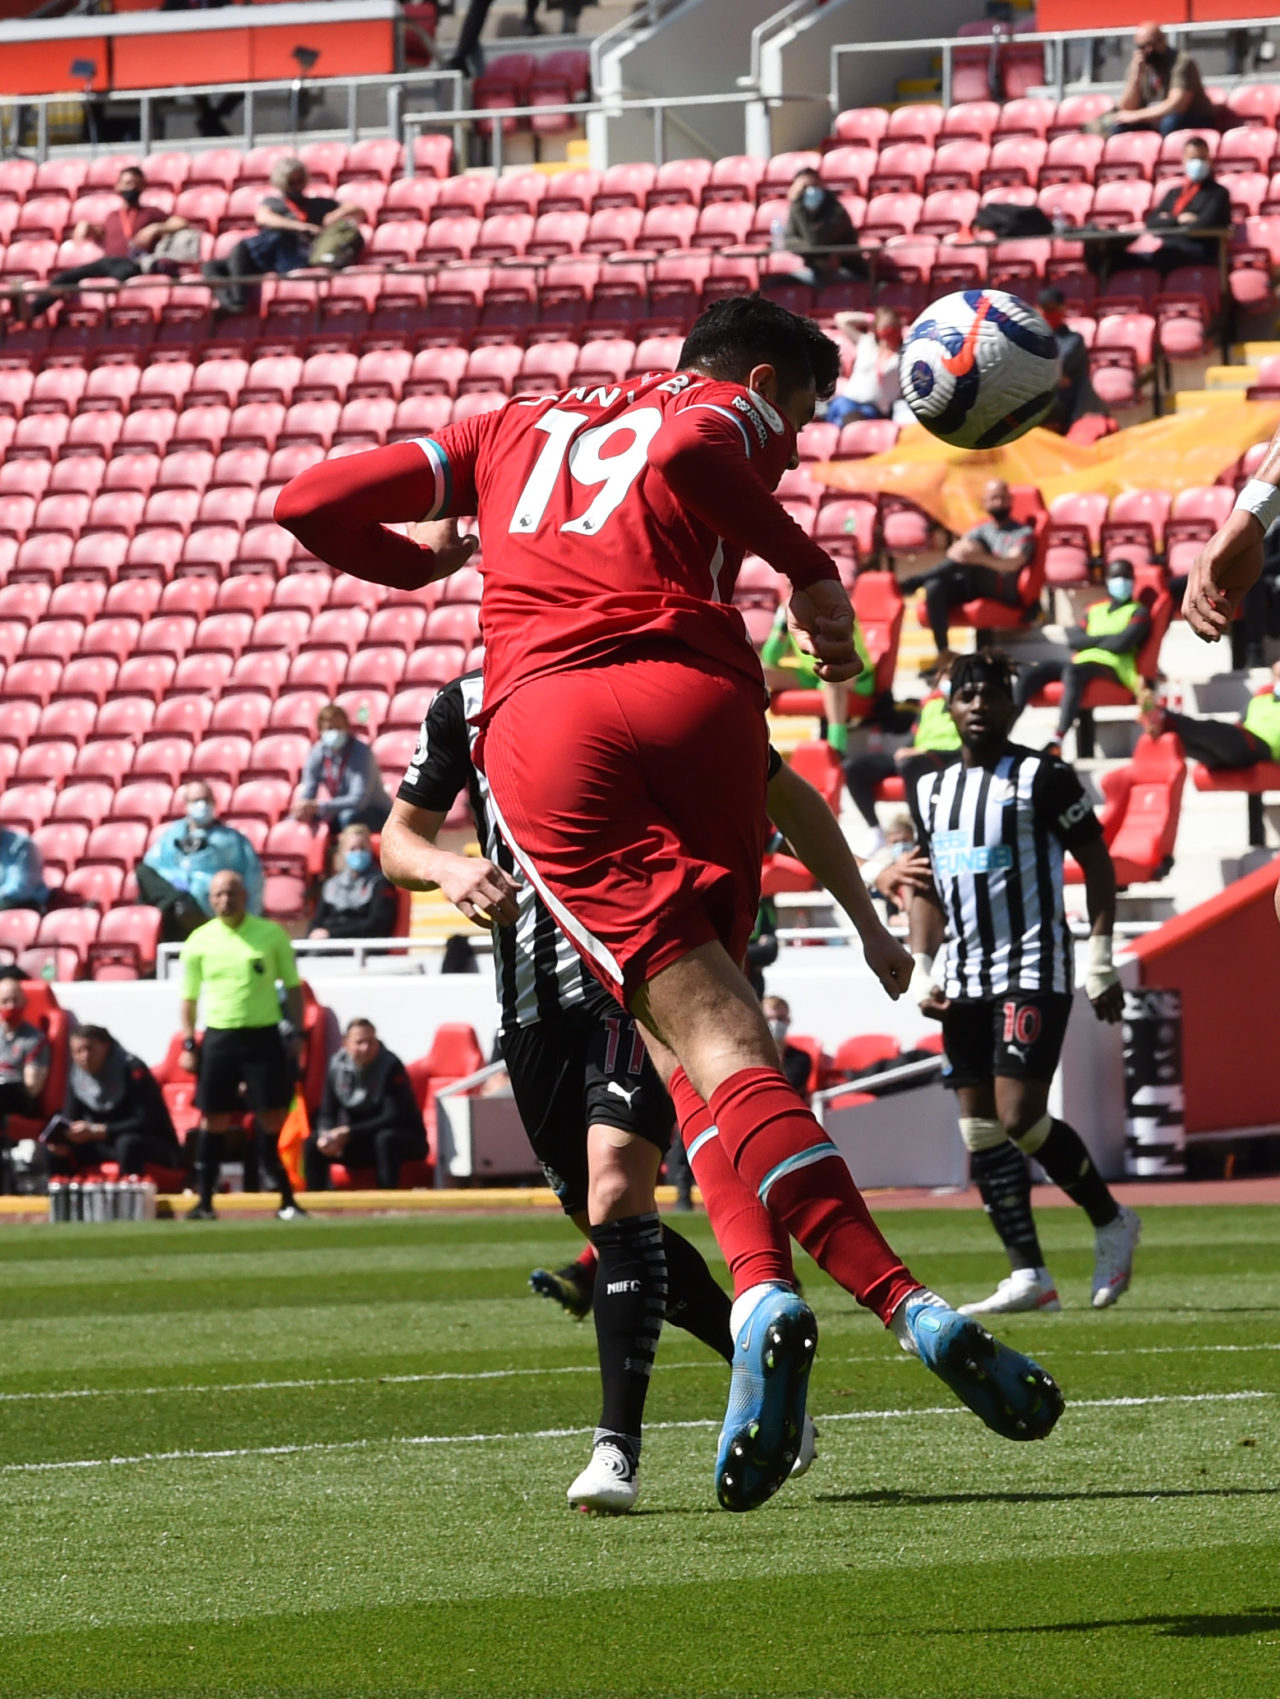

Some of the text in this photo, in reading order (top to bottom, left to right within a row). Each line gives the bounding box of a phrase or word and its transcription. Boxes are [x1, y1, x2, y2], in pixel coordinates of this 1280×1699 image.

[508, 407, 663, 536] 19
[604, 1017, 646, 1075] 11
[1003, 1001, 1041, 1043] 10
[607, 1280, 641, 1295] NUFC
